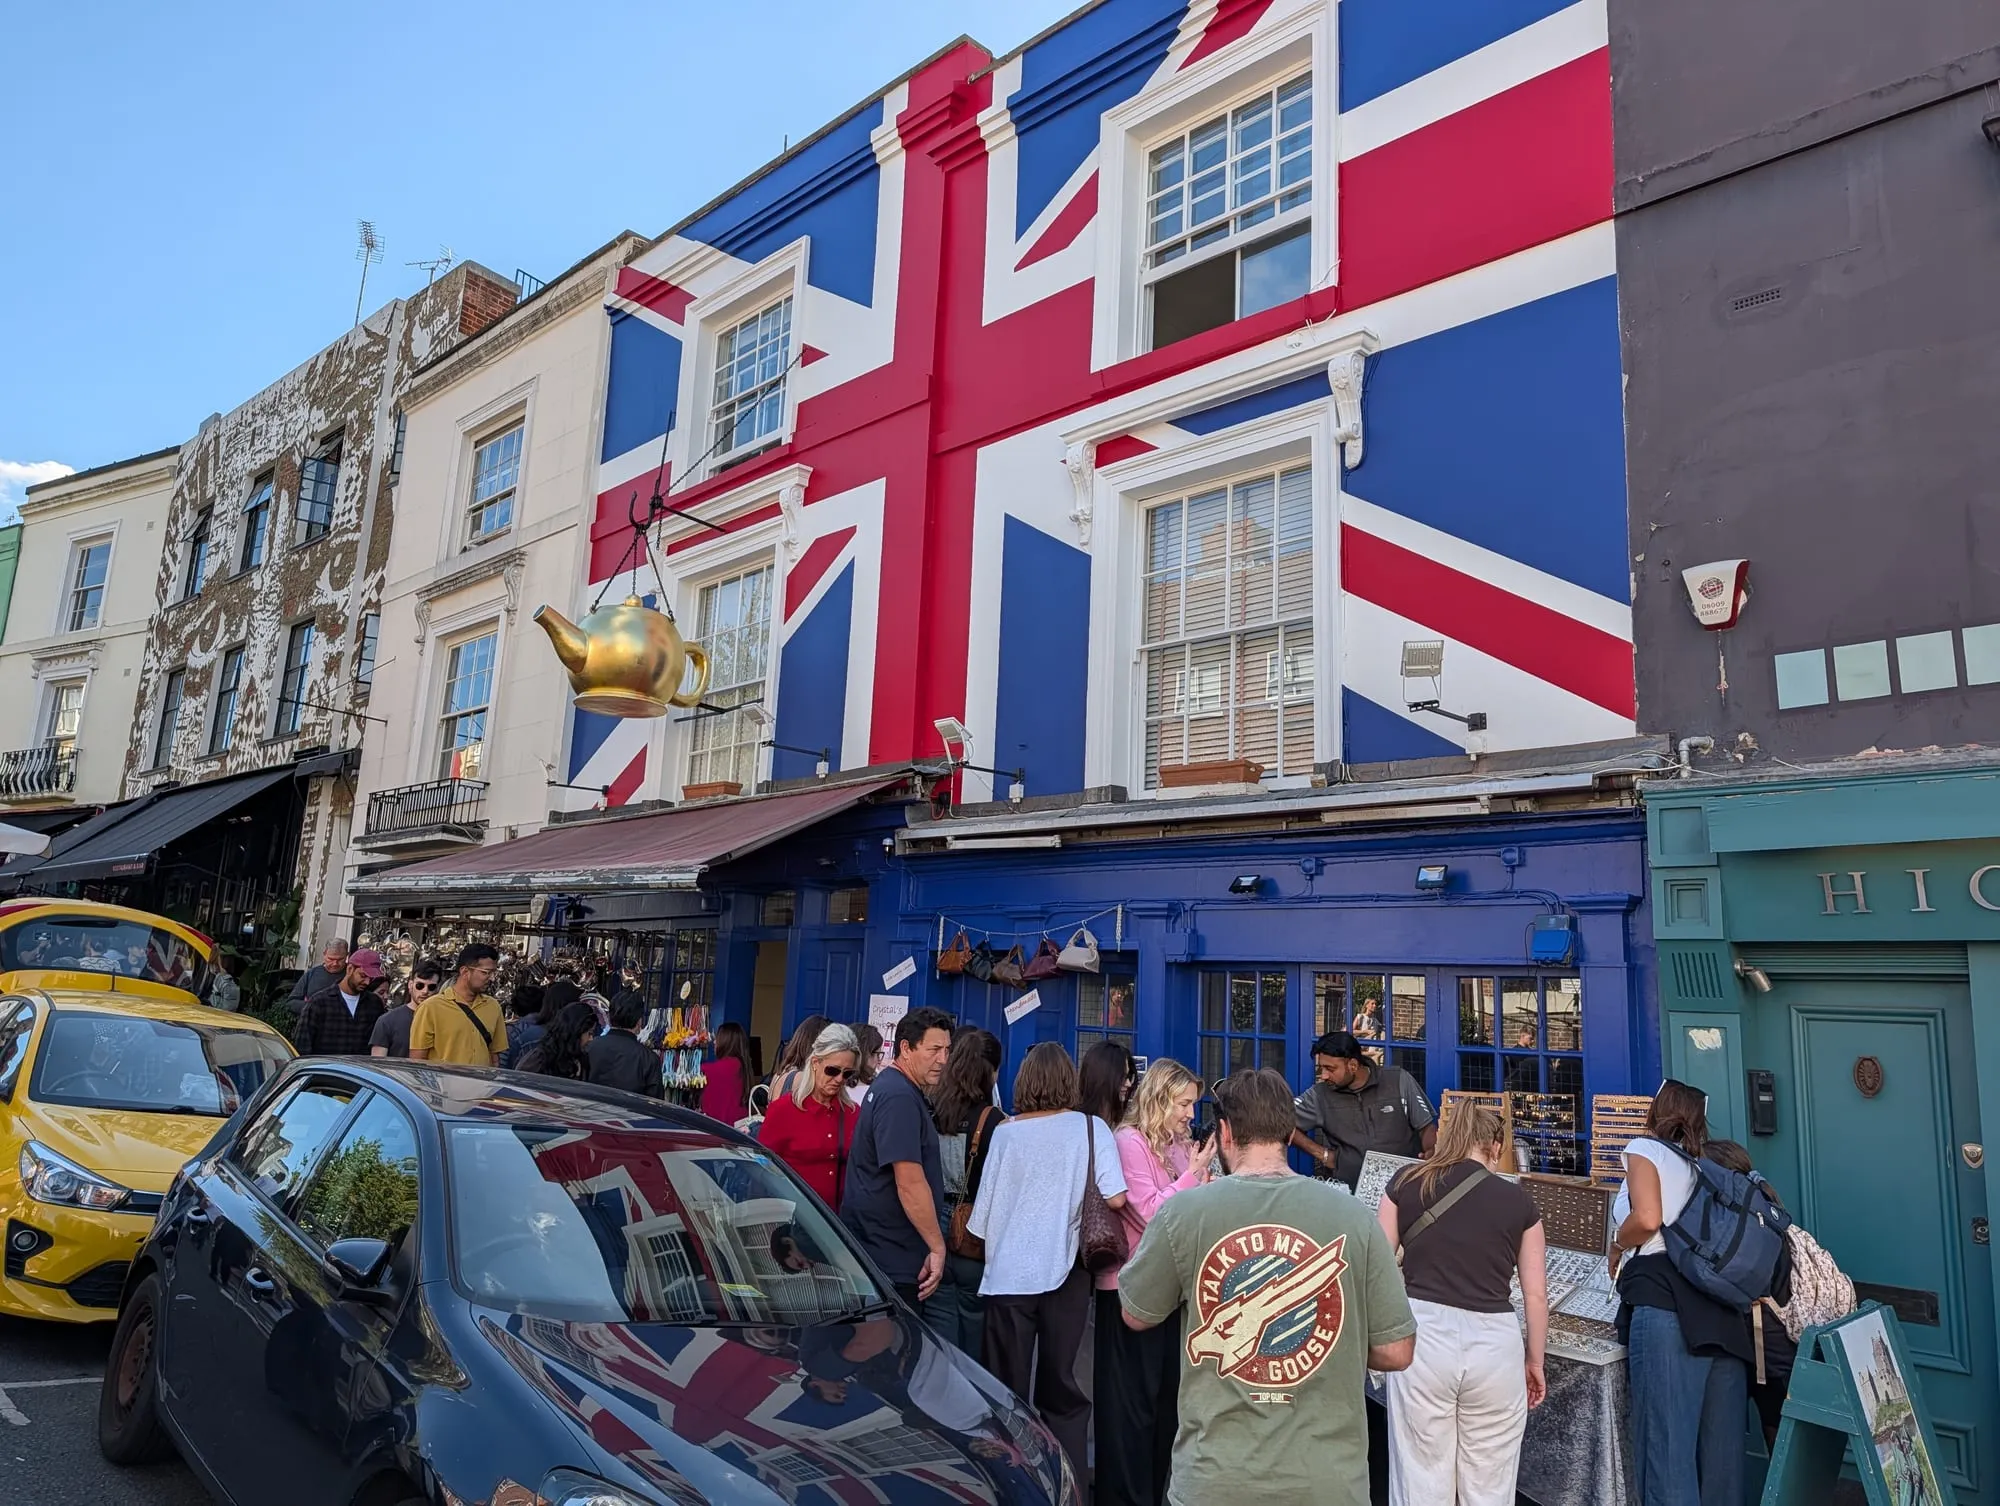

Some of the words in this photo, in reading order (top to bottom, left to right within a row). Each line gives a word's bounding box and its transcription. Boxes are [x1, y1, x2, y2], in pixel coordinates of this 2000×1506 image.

[1203, 1247, 1237, 1303] TALK
[1236, 1232, 1264, 1256] TO
[1273, 1233, 1306, 1260] ME
[1268, 1324, 1334, 1381] GOOSE
[1259, 1392, 1271, 1401] TOP
